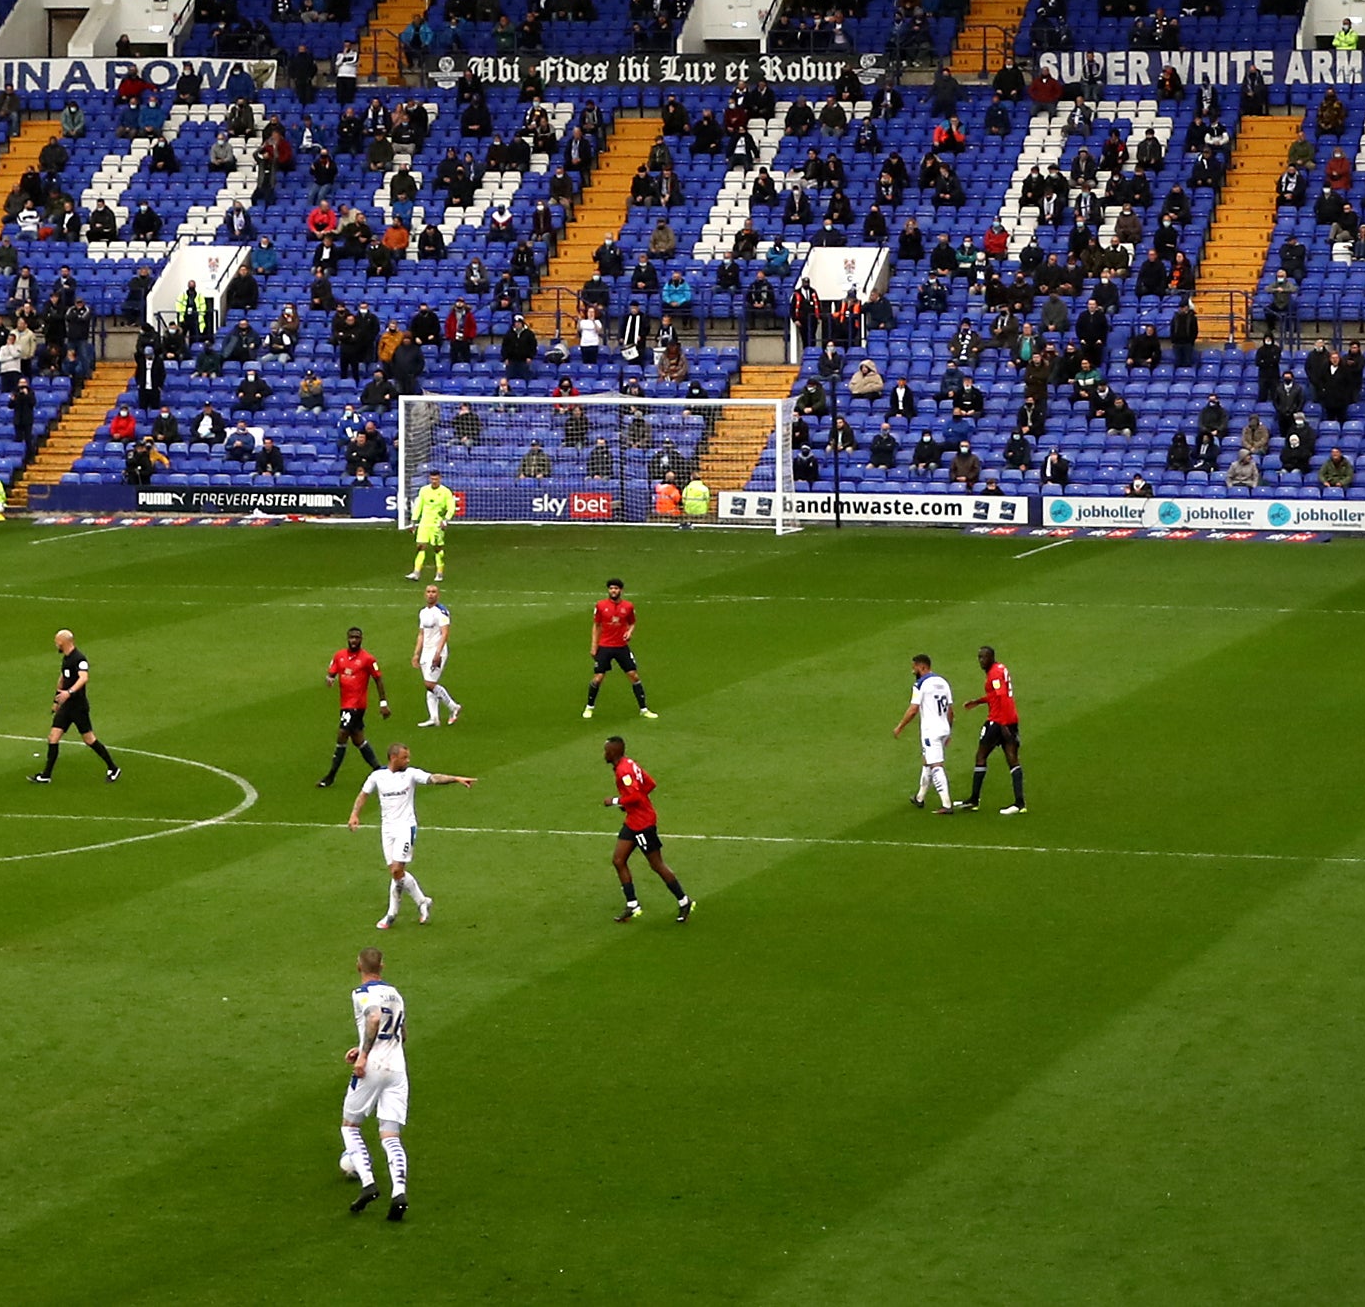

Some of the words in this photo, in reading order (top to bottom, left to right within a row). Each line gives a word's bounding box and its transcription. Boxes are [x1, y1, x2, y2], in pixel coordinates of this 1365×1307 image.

[4, 61, 51, 92] IN
[58, 60, 97, 92] A
[618, 55, 650, 83] ibi
[659, 55, 717, 83] Lux
[724, 57, 751, 83] et
[1039, 51, 1150, 85] SUPER
[1161, 50, 1275, 85] WHITE
[138, 492, 173, 505] PUMA
[299, 493, 332, 506] PUMA
[532, 493, 567, 516] sky
[574, 495, 608, 513] bet
[783, 496, 962, 516] bandmwaste.com
[1076, 502, 1145, 521] jobholler
[1185, 503, 1255, 522] jobholler
[1294, 505, 1365, 524] jobholler
[403, 842, 409, 853] 8
[636, 834, 647, 845] 11
